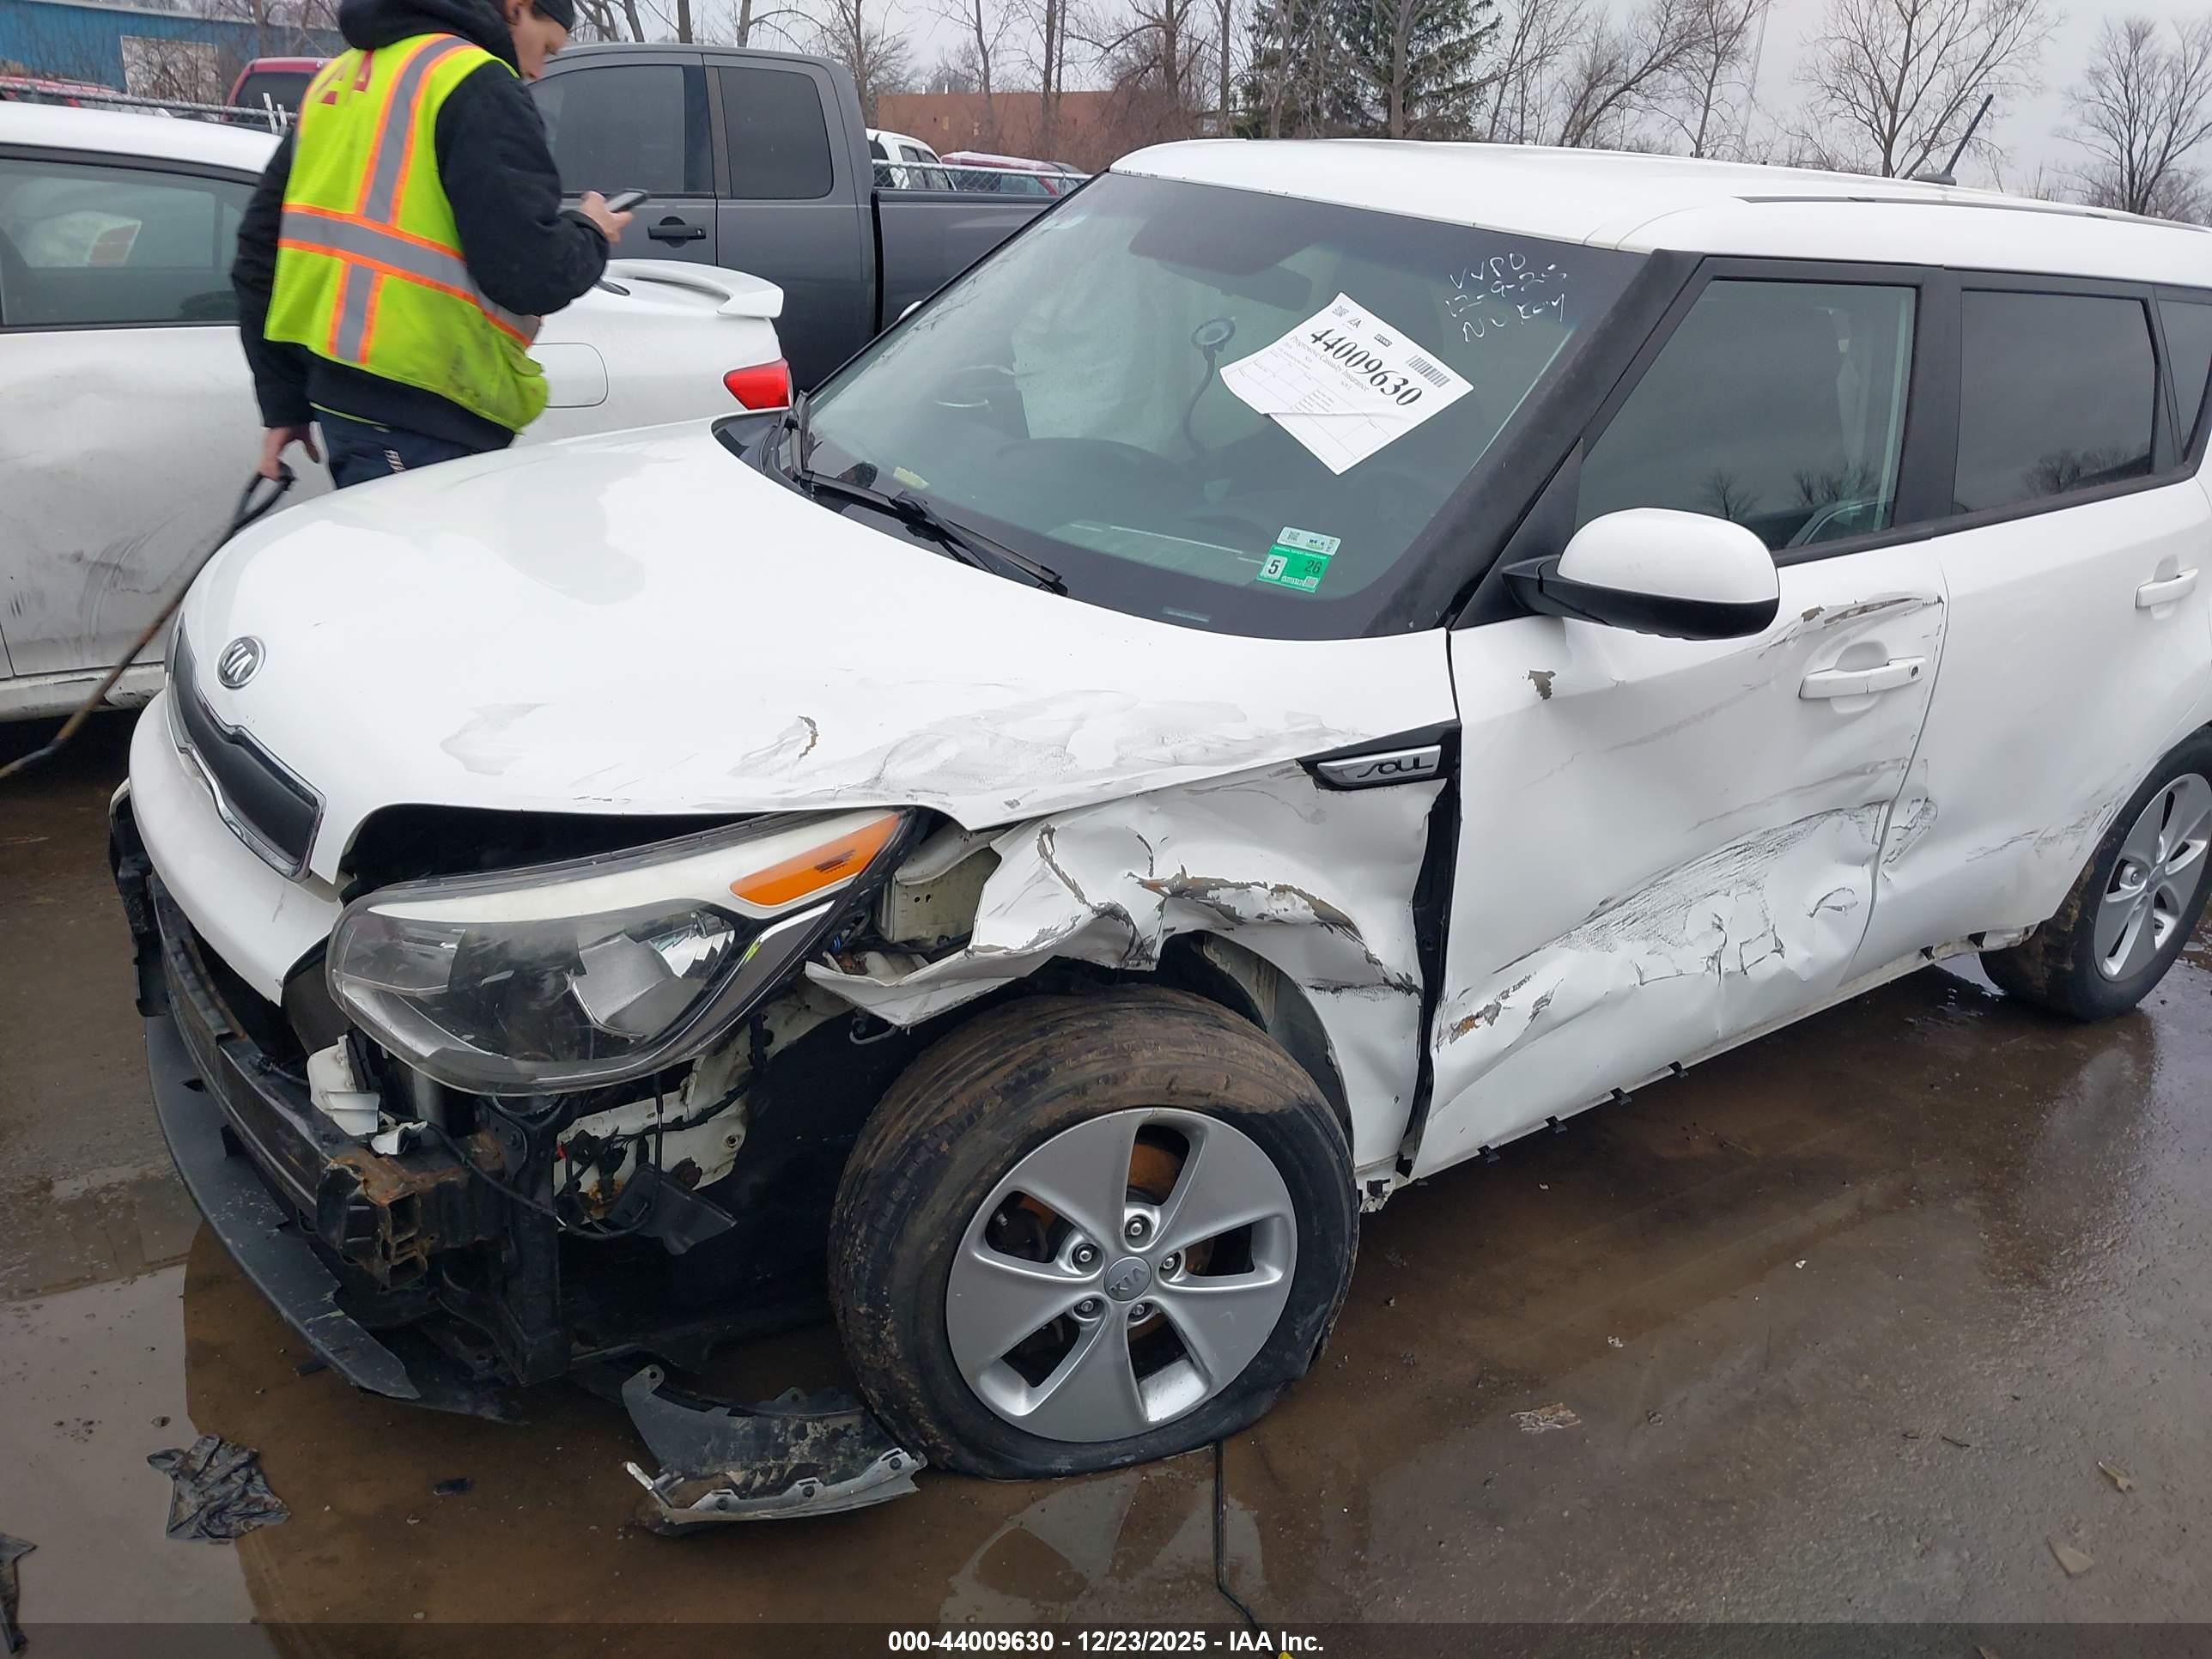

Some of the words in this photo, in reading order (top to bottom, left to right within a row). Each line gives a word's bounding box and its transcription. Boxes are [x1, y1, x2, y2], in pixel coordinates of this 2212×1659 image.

[1310, 328, 1423, 406] 44009630
[1267, 559, 1281, 574] 5
[1305, 560, 1322, 574] 26
[1109, 1266, 1147, 1297] KIA
